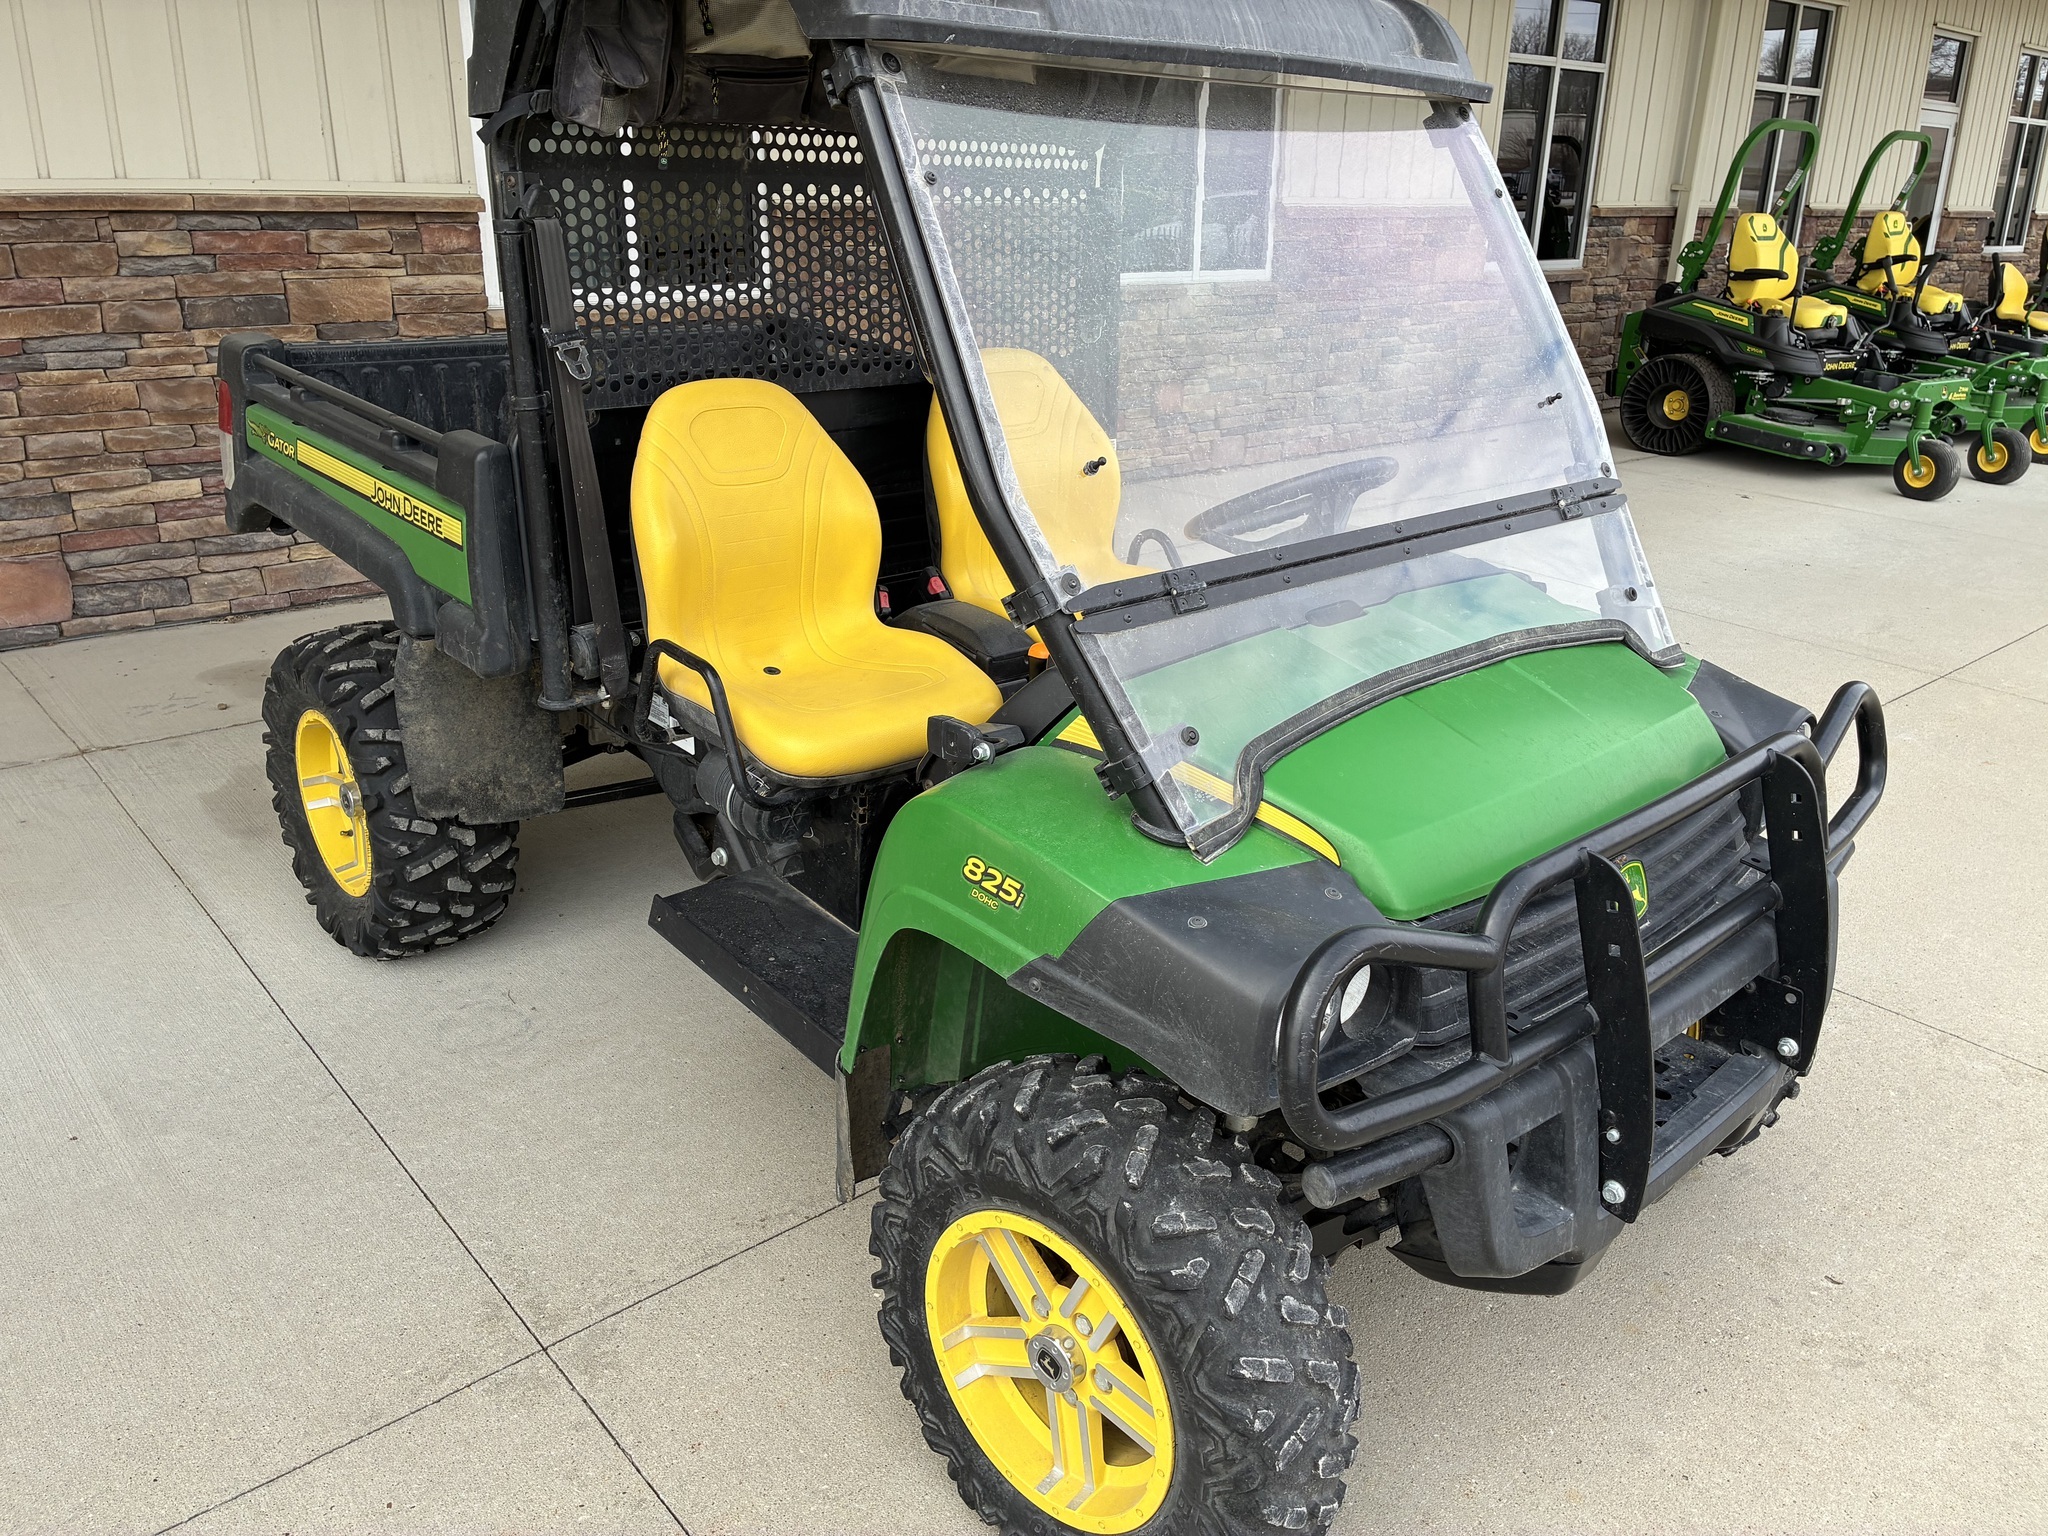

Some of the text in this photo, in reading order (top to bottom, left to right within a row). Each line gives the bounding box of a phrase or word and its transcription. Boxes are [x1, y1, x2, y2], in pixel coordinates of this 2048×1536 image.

[1728, 314, 1744, 322] DEERE
[1824, 361, 1856, 371] JOHN DEERE
[267, 431, 296, 460] GATOR
[371, 481, 444, 536] JOHN DEERE
[962, 856, 1025, 910] 825i
[971, 888, 999, 910] DOHC
